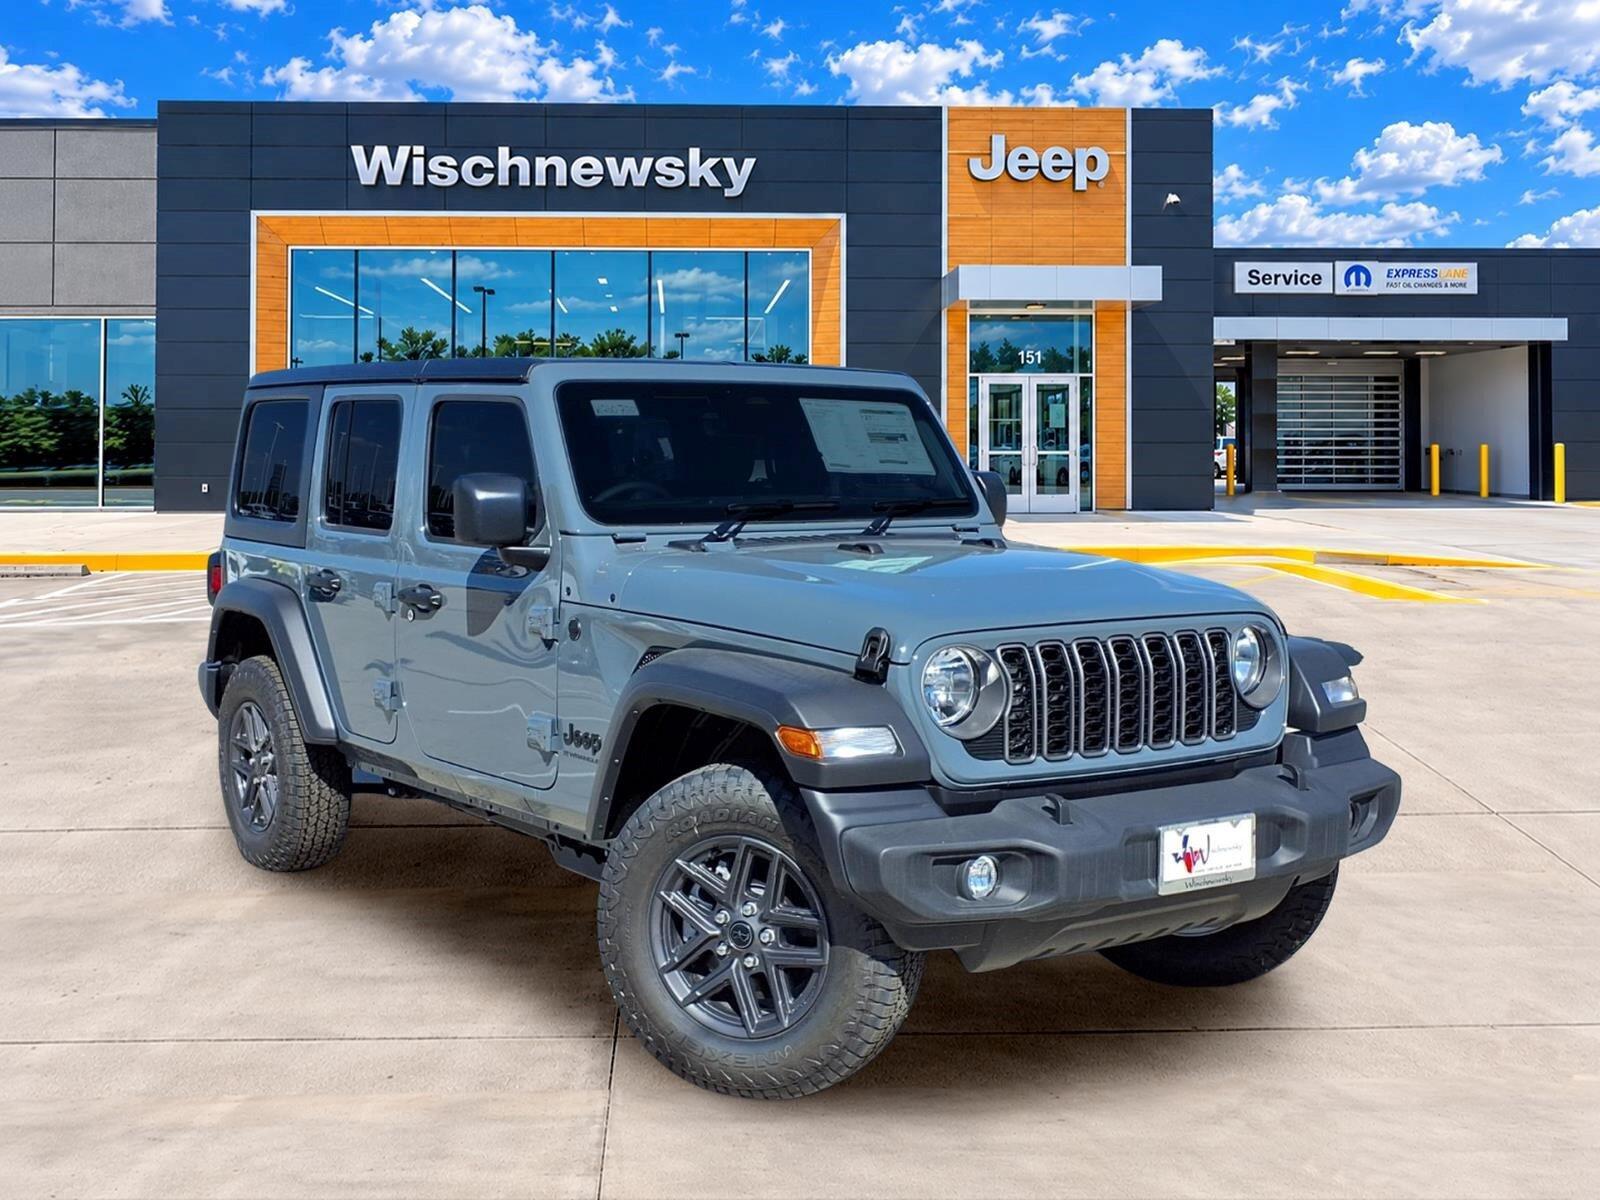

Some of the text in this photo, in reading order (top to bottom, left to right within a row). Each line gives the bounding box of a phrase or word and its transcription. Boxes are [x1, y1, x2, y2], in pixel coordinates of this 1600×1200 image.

[350, 144, 757, 197] Wischnewsky
[968, 133, 1110, 191] Jeep
[1248, 268, 1323, 286] Service
[1385, 281, 1401, 289] FAST
[1017, 349, 1041, 365] 151
[563, 722, 602, 756] Jeep
